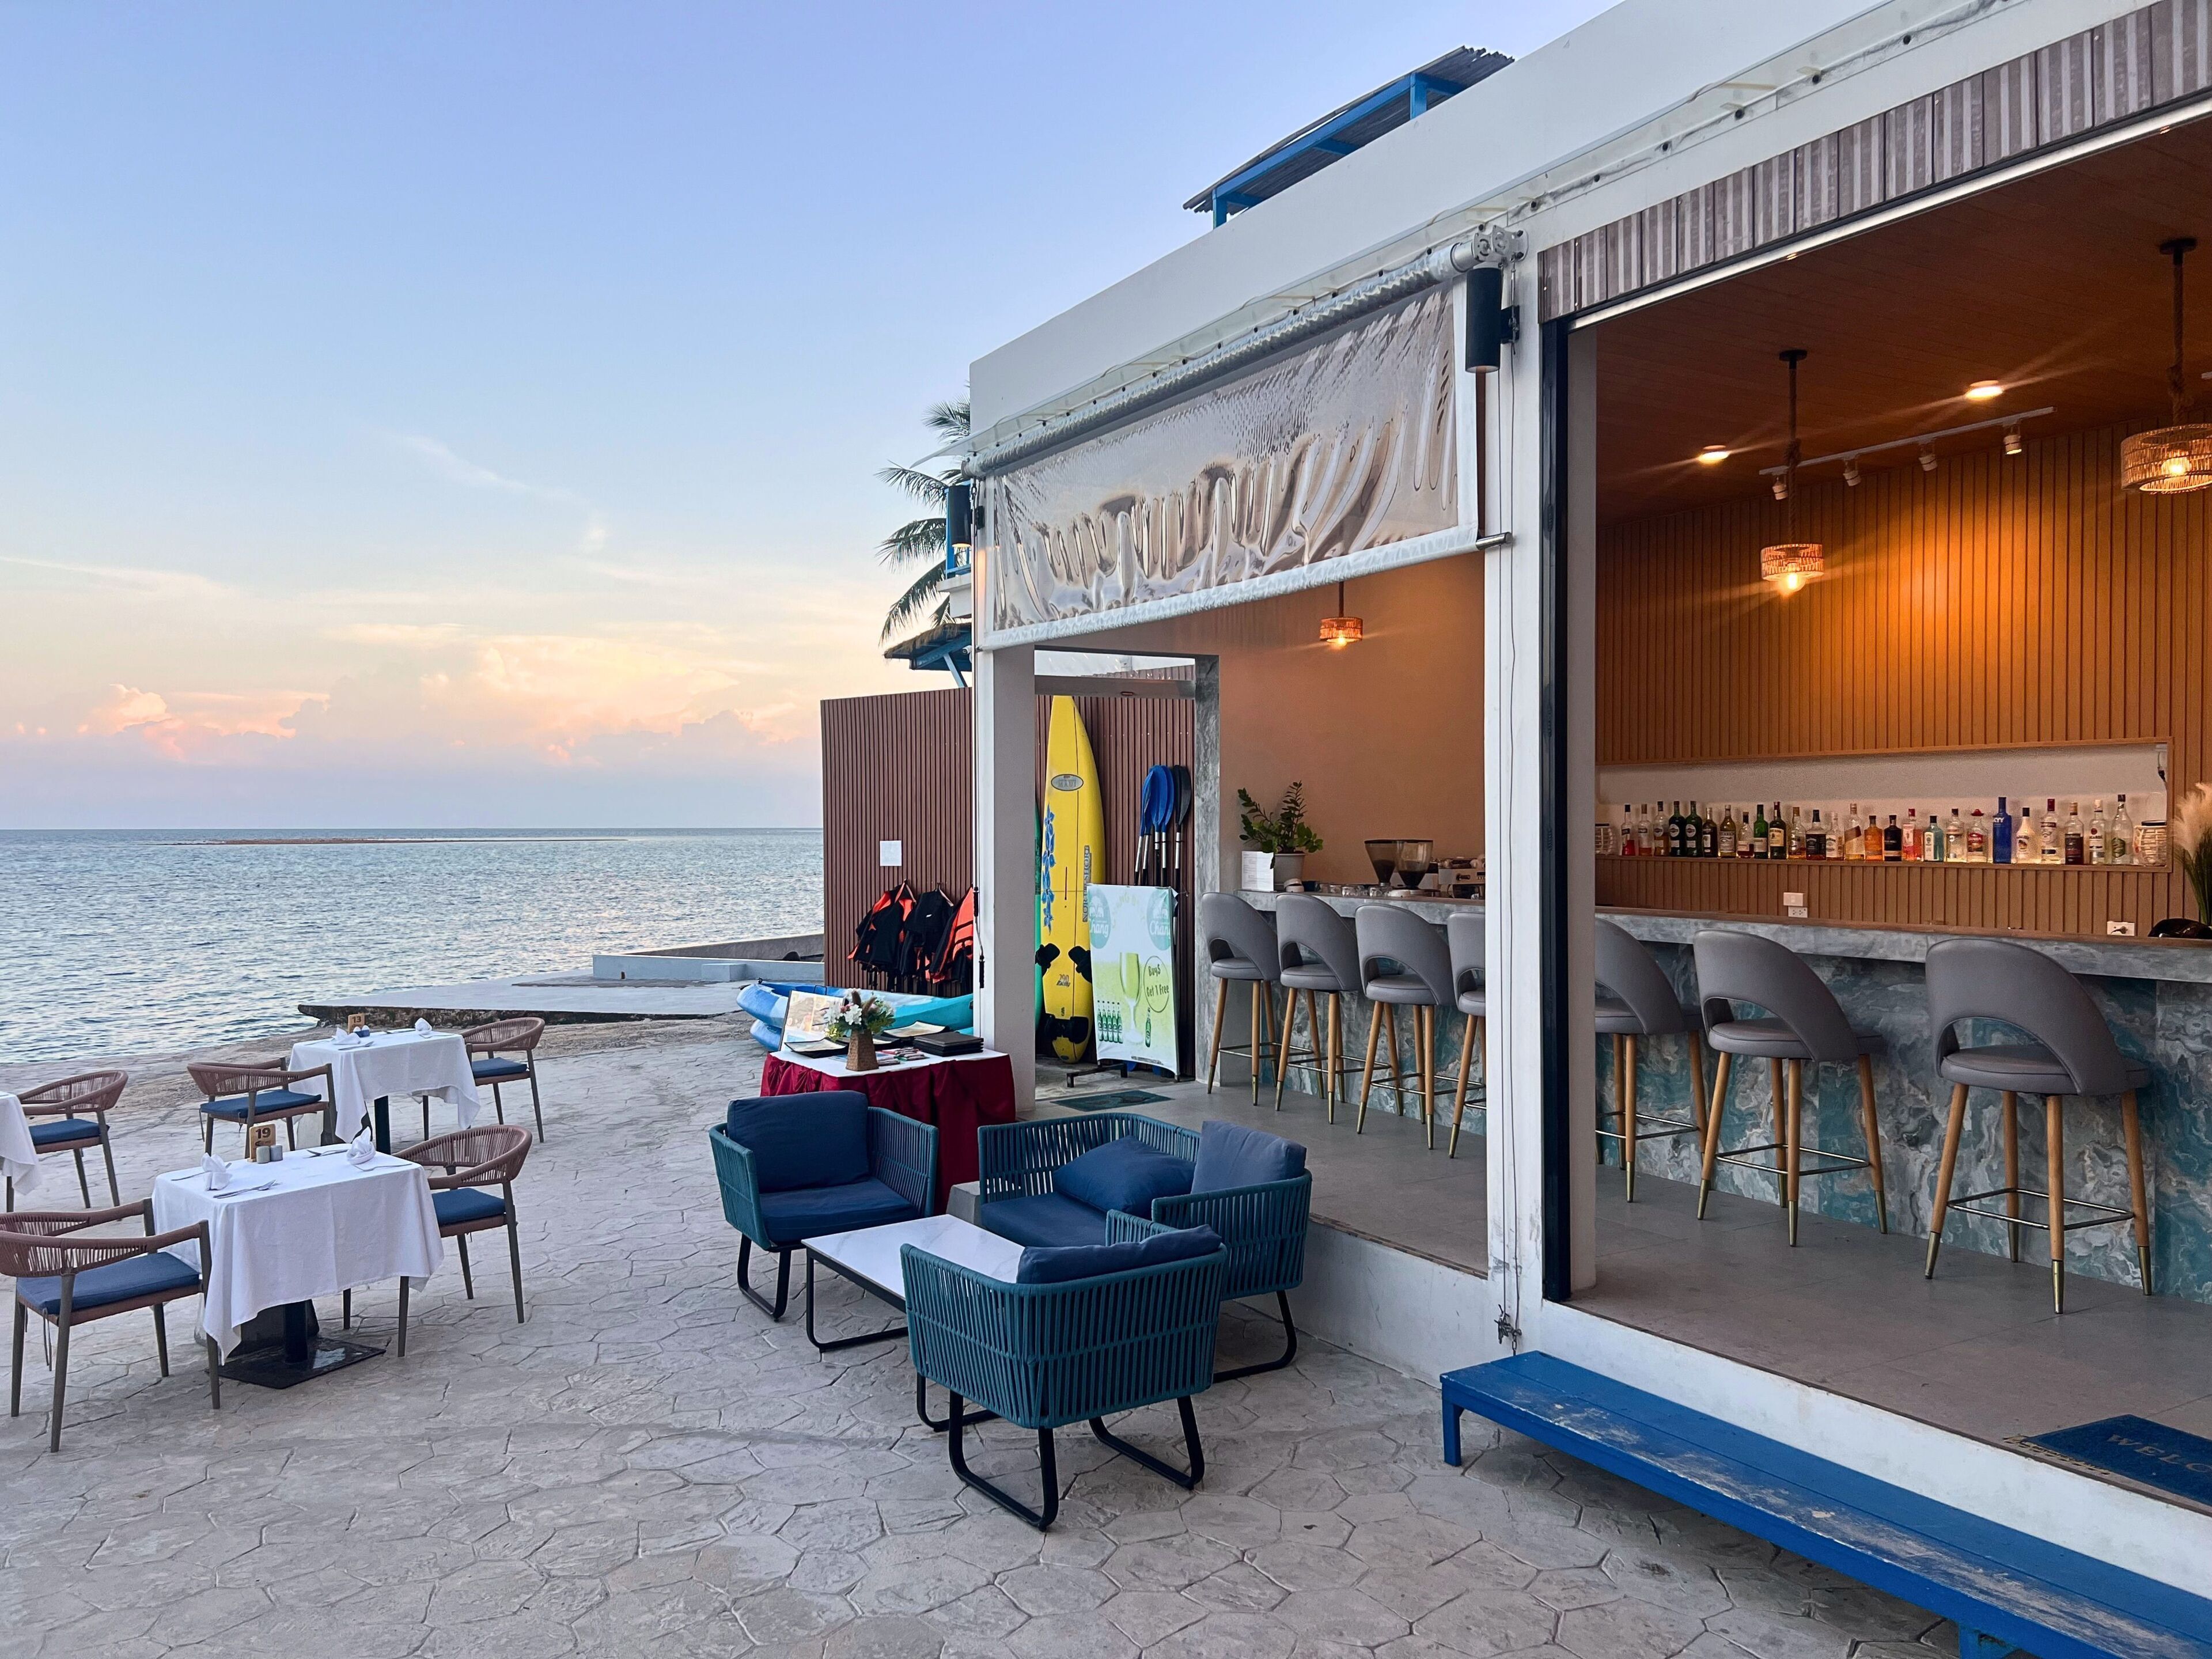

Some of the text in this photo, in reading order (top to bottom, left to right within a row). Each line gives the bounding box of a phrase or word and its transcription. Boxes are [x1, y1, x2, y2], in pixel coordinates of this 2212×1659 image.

[1146, 986, 1154, 997] Get
[1159, 983, 1169, 995] Free
[256, 1127, 271, 1139] 19
